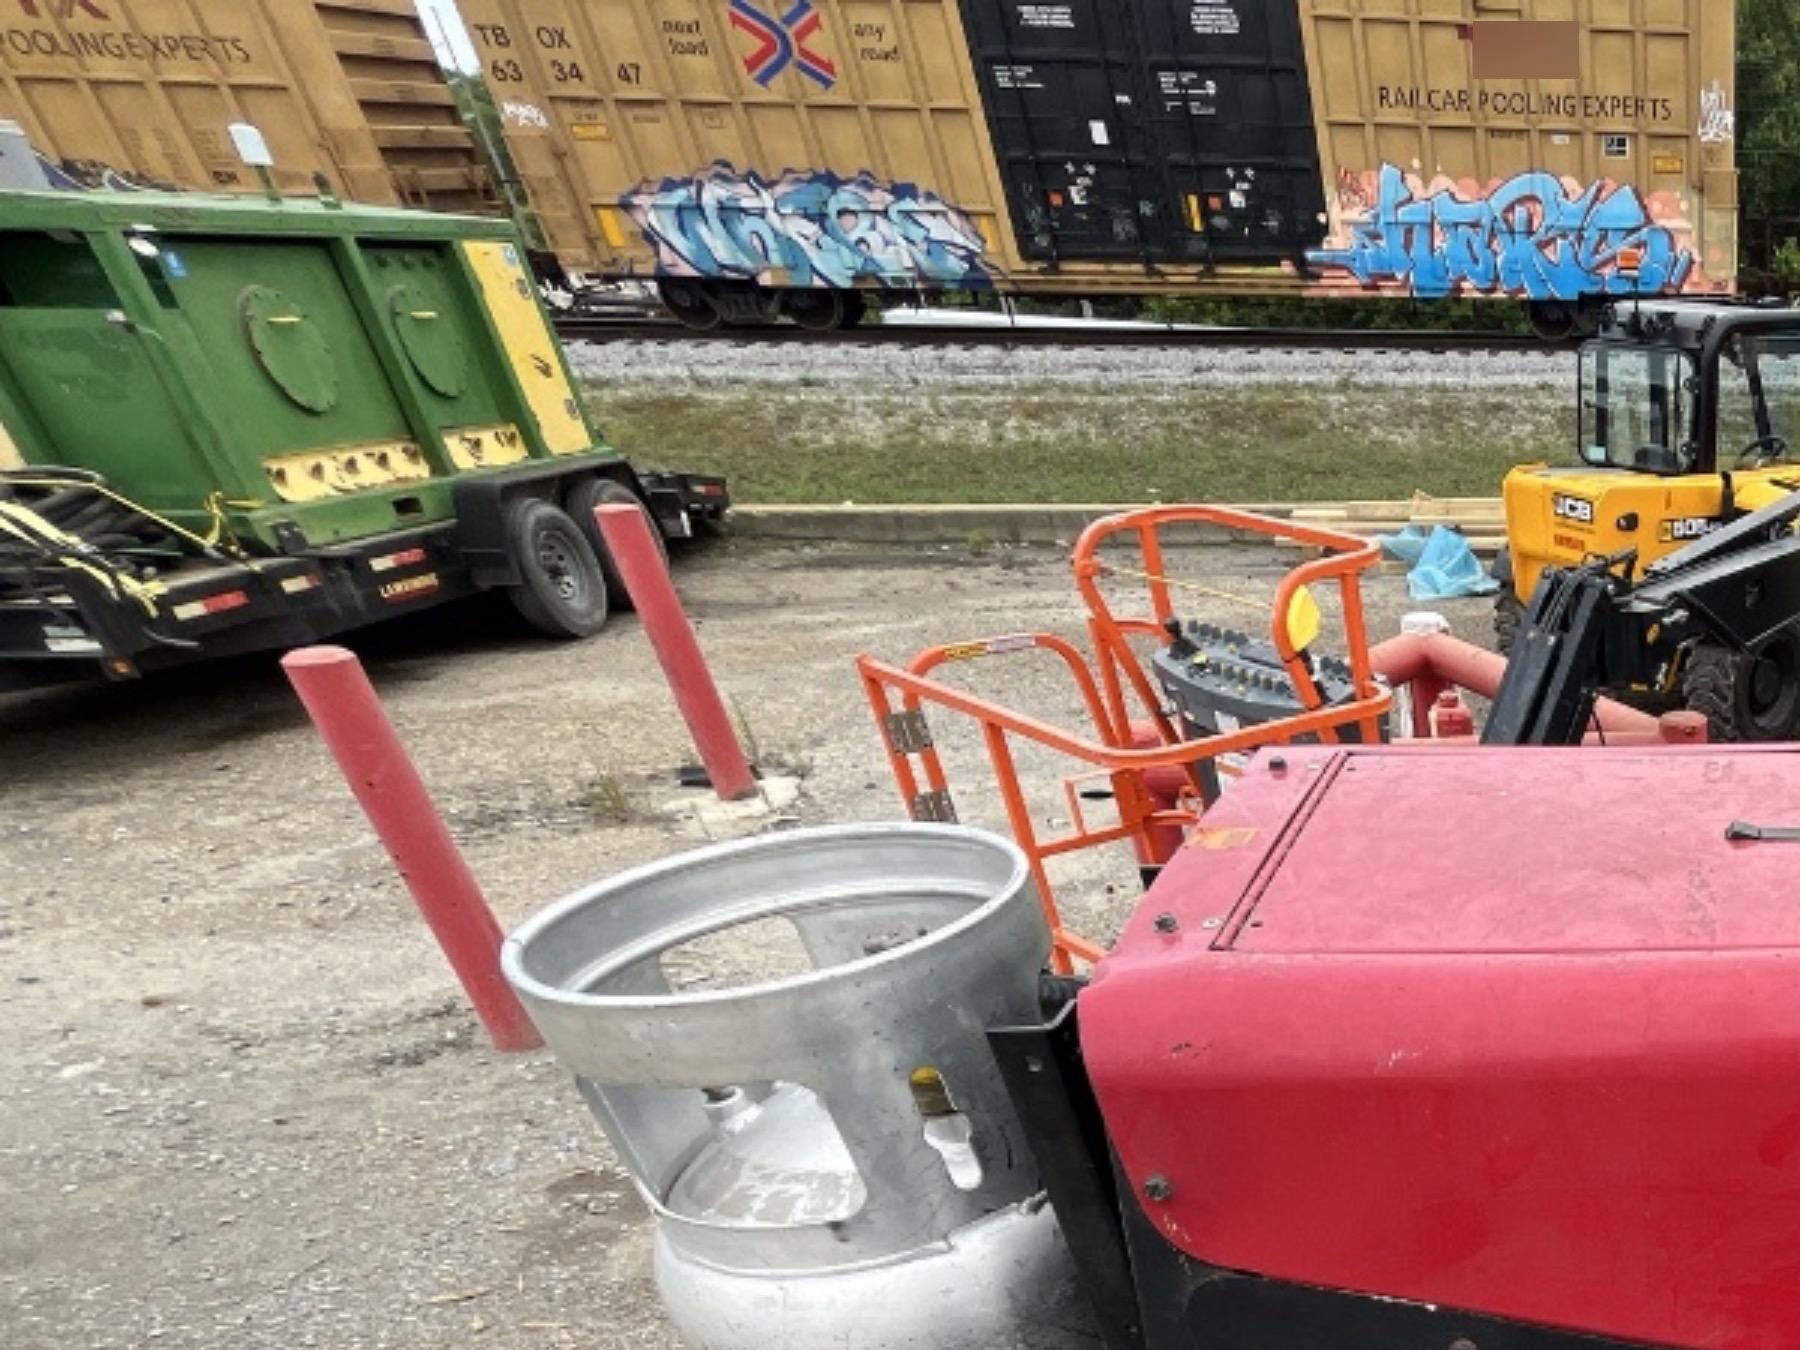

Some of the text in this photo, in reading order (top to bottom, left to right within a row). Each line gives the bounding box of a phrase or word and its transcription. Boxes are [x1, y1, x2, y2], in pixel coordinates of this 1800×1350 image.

[124, 32, 252, 64] EXPERTS
[474, 23, 571, 50] TB OX
[491, 59, 641, 85] 63 34 47
[1378, 86, 1471, 113] RAILCAR
[1478, 93, 1577, 119] POOLING
[1584, 95, 1673, 122] EXPERTS
